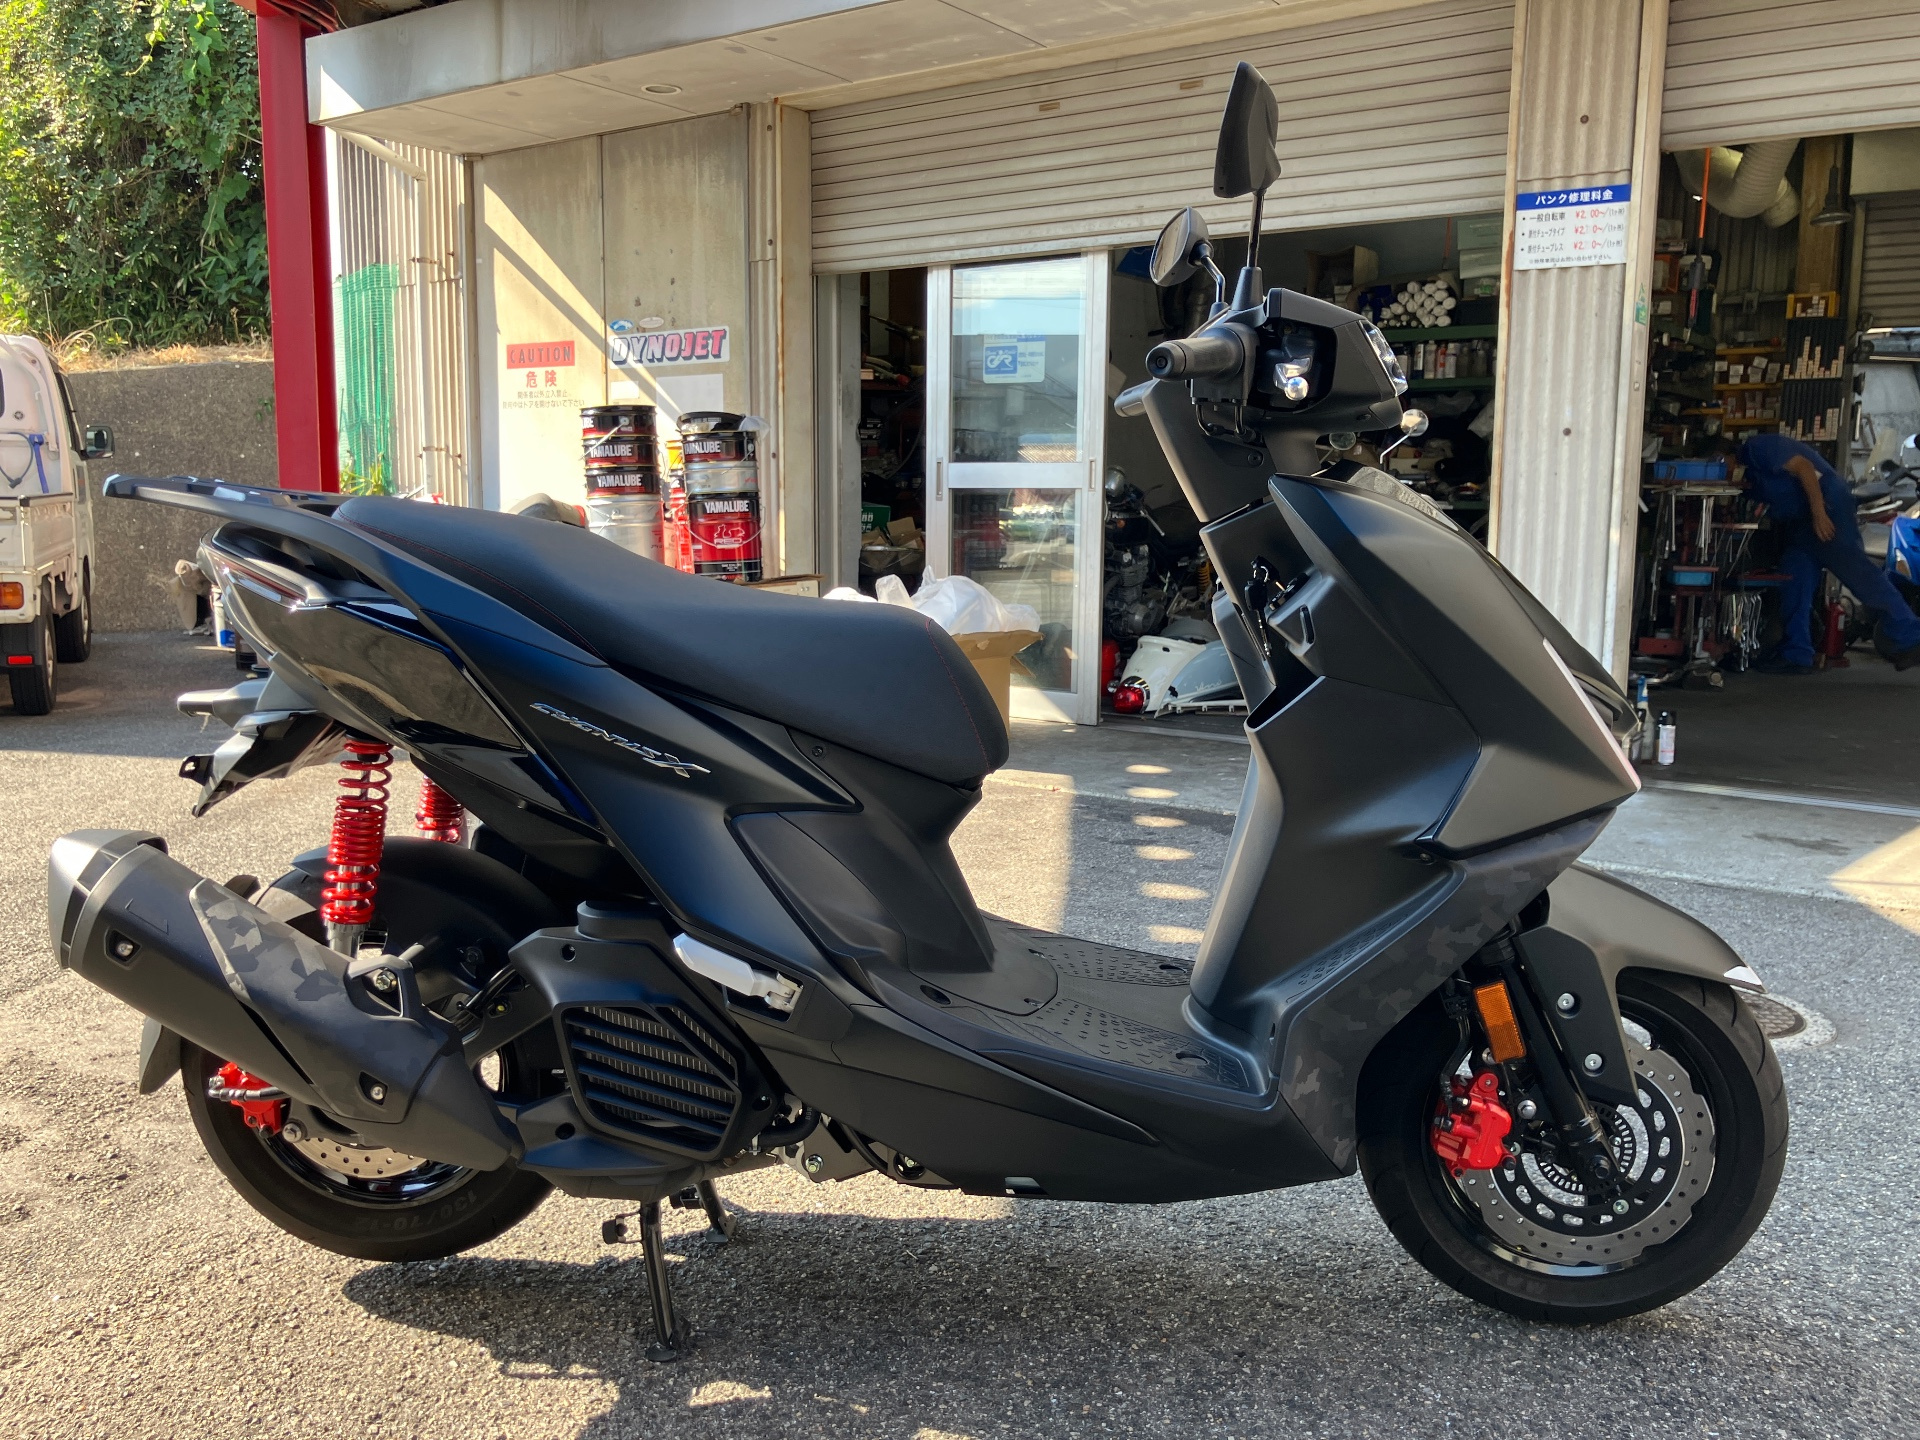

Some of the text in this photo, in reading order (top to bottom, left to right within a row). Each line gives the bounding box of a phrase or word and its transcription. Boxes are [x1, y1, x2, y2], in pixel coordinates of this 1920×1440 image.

[510, 346, 571, 364] CAUTION
[612, 329, 727, 365] DYNOJET
[526, 370, 557, 388] 危険
[597, 474, 642, 488] YAMALUBE
[704, 500, 749, 514] YAMALUBE
